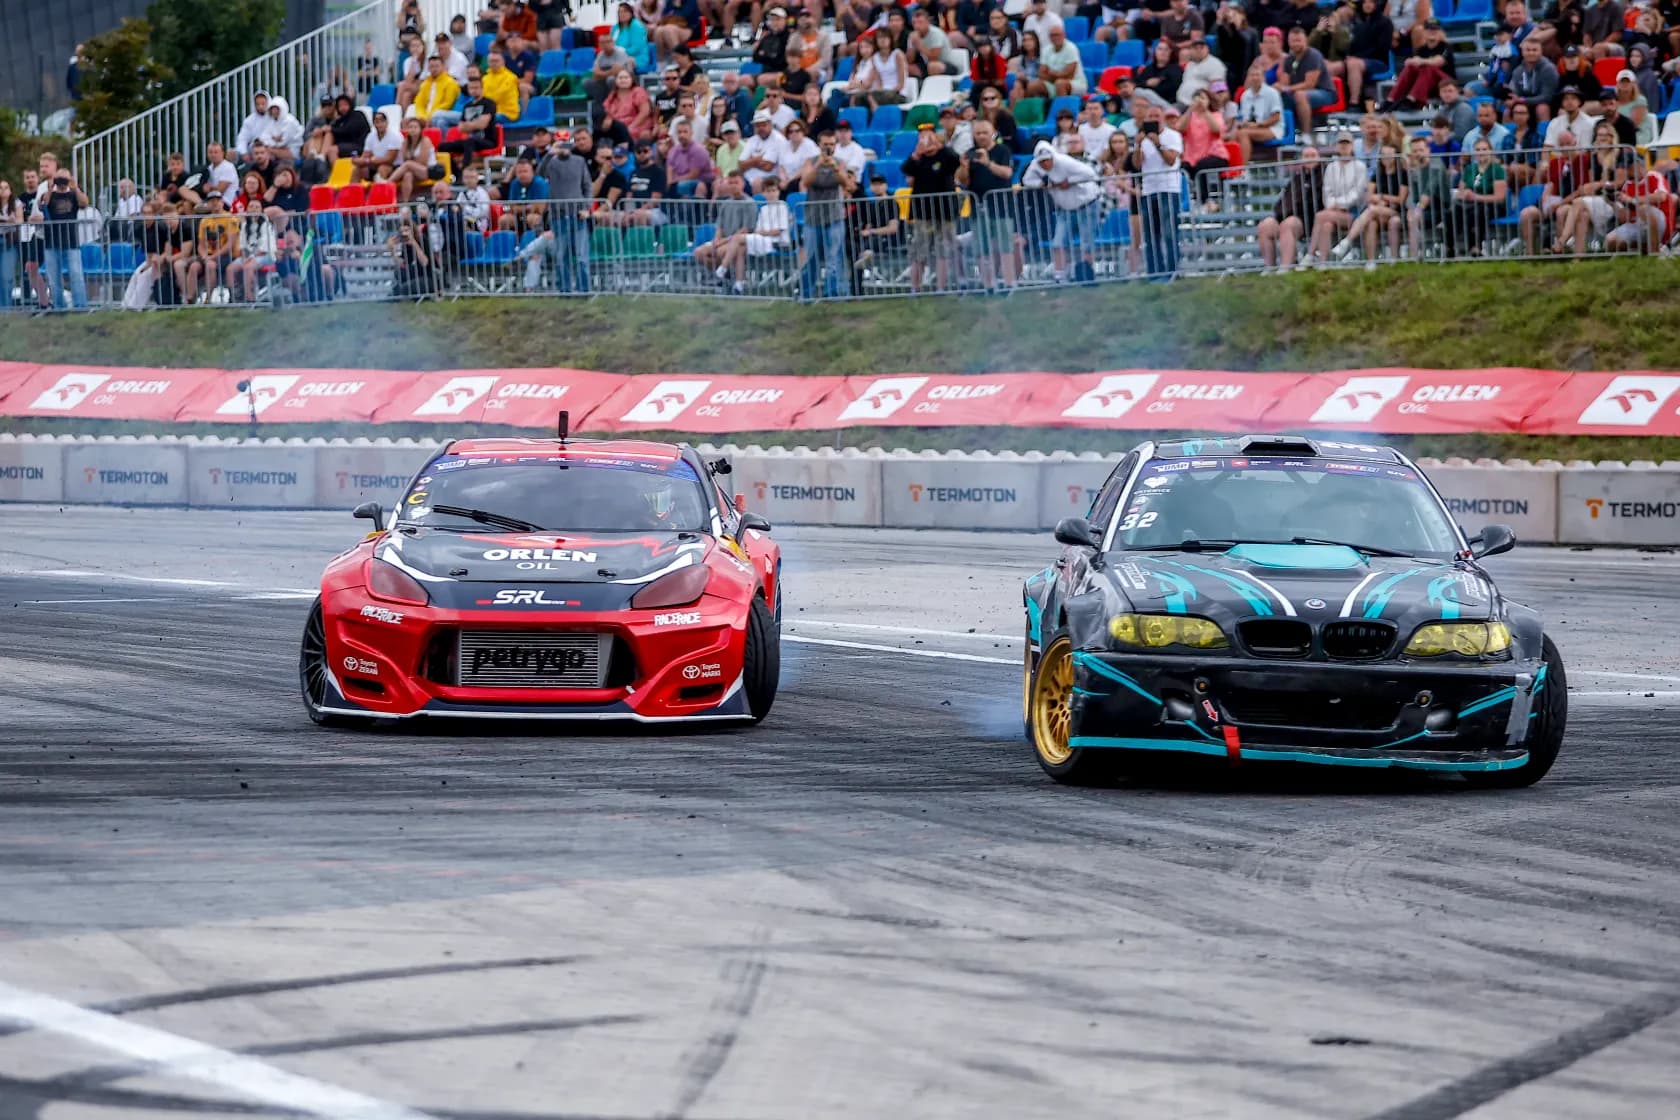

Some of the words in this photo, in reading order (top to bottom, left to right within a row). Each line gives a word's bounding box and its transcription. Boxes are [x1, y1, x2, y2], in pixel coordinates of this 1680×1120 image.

[106, 380, 171, 394] ORLEN
[297, 382, 366, 396] ORLEN
[497, 383, 570, 399] ORLEN
[927, 384, 1005, 400] ORLEN
[1160, 384, 1244, 401] ORLEN
[1412, 385, 1501, 402] ORLEN
[709, 389, 784, 405] ORLEN
[695, 405, 723, 417] OIL
[913, 402, 941, 413] OIL
[99, 470, 169, 485] TERMOTON
[224, 471, 297, 485] TERMOTON
[771, 485, 855, 501] TERMOTON
[927, 487, 1016, 502] TERMOTON
[1446, 499, 1528, 514] RMOTON
[1119, 511, 1159, 530] 32
[483, 548, 598, 562] ORLEN
[515, 562, 559, 570] OIL
[493, 589, 552, 605] SRL
[358, 658, 378, 667] Toyota
[472, 645, 585, 675] petrygo
